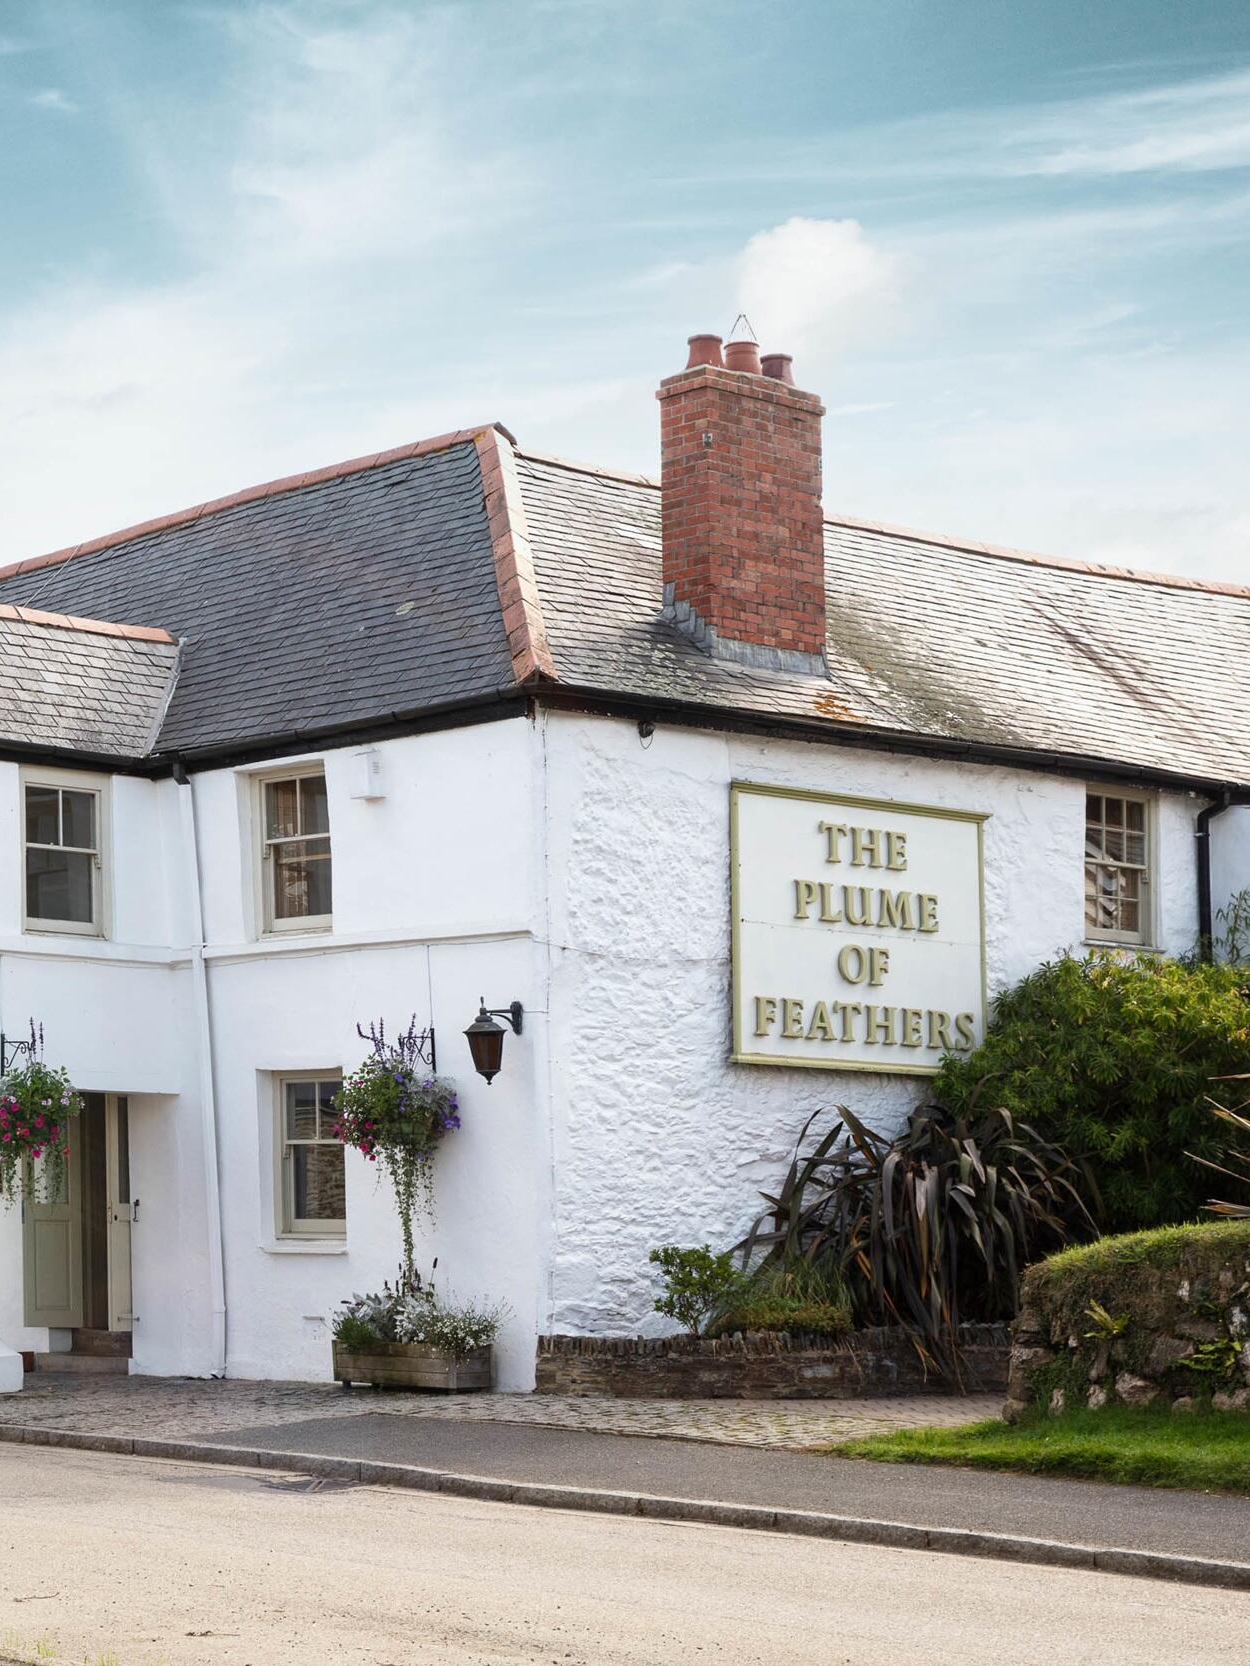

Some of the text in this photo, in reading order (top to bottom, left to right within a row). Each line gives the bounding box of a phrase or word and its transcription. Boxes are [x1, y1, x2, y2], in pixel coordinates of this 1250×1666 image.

[819, 820, 907, 870] THE
[793, 879, 939, 932] PLUME
[838, 944, 889, 986] OF
[754, 996, 975, 1051] FEATHERS
